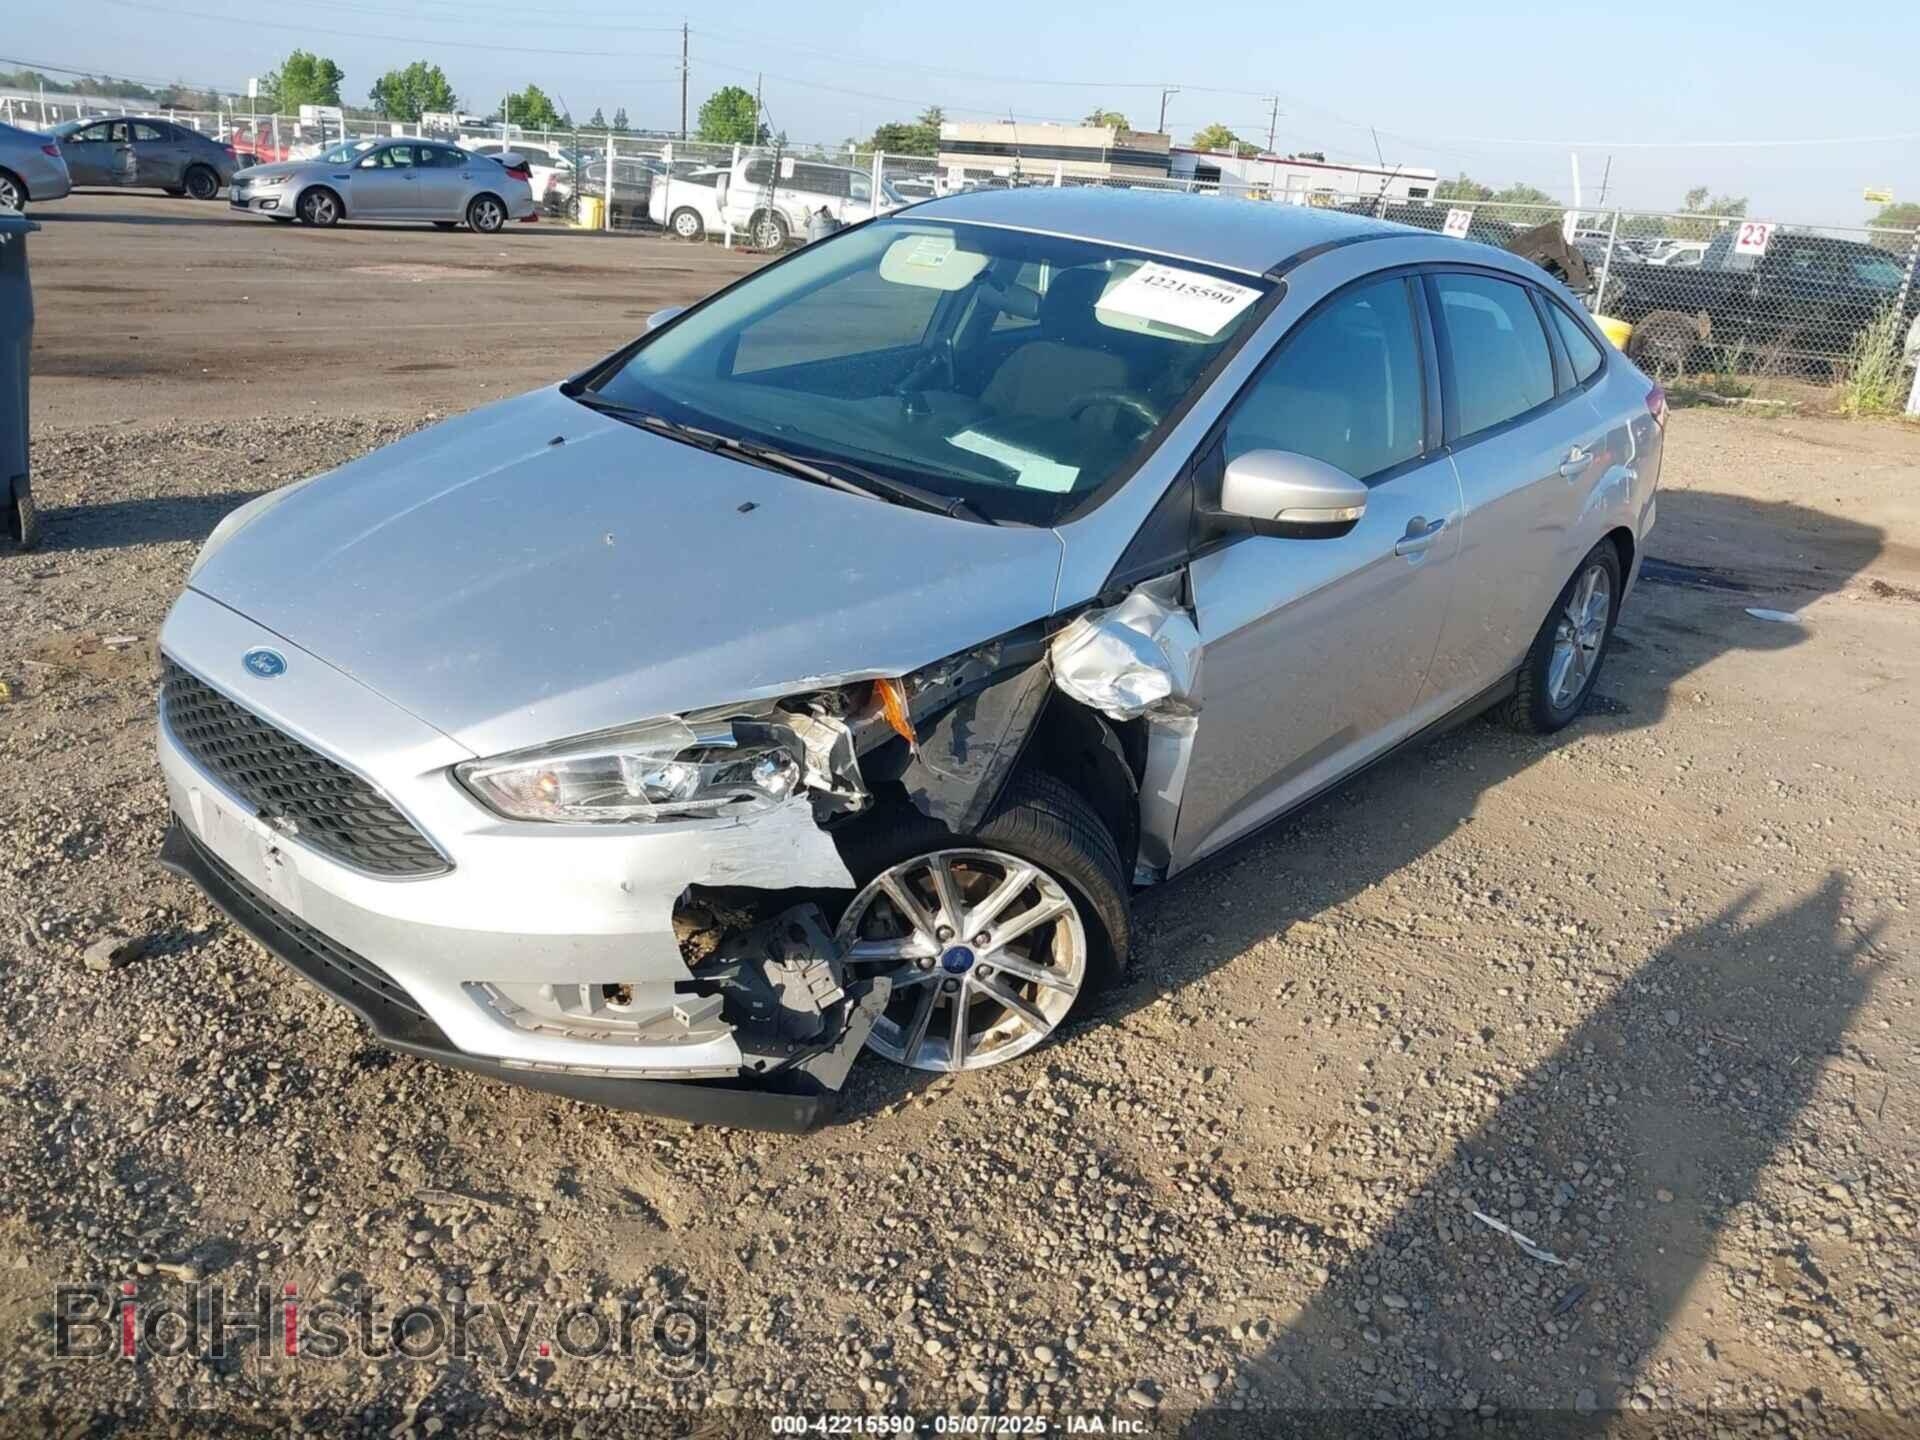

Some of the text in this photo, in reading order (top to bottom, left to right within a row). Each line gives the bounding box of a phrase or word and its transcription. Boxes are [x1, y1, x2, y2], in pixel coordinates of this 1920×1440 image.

[1449, 211, 1469, 232] 22
[1741, 224, 1767, 246] 23
[1141, 275, 1235, 304] 42215590
